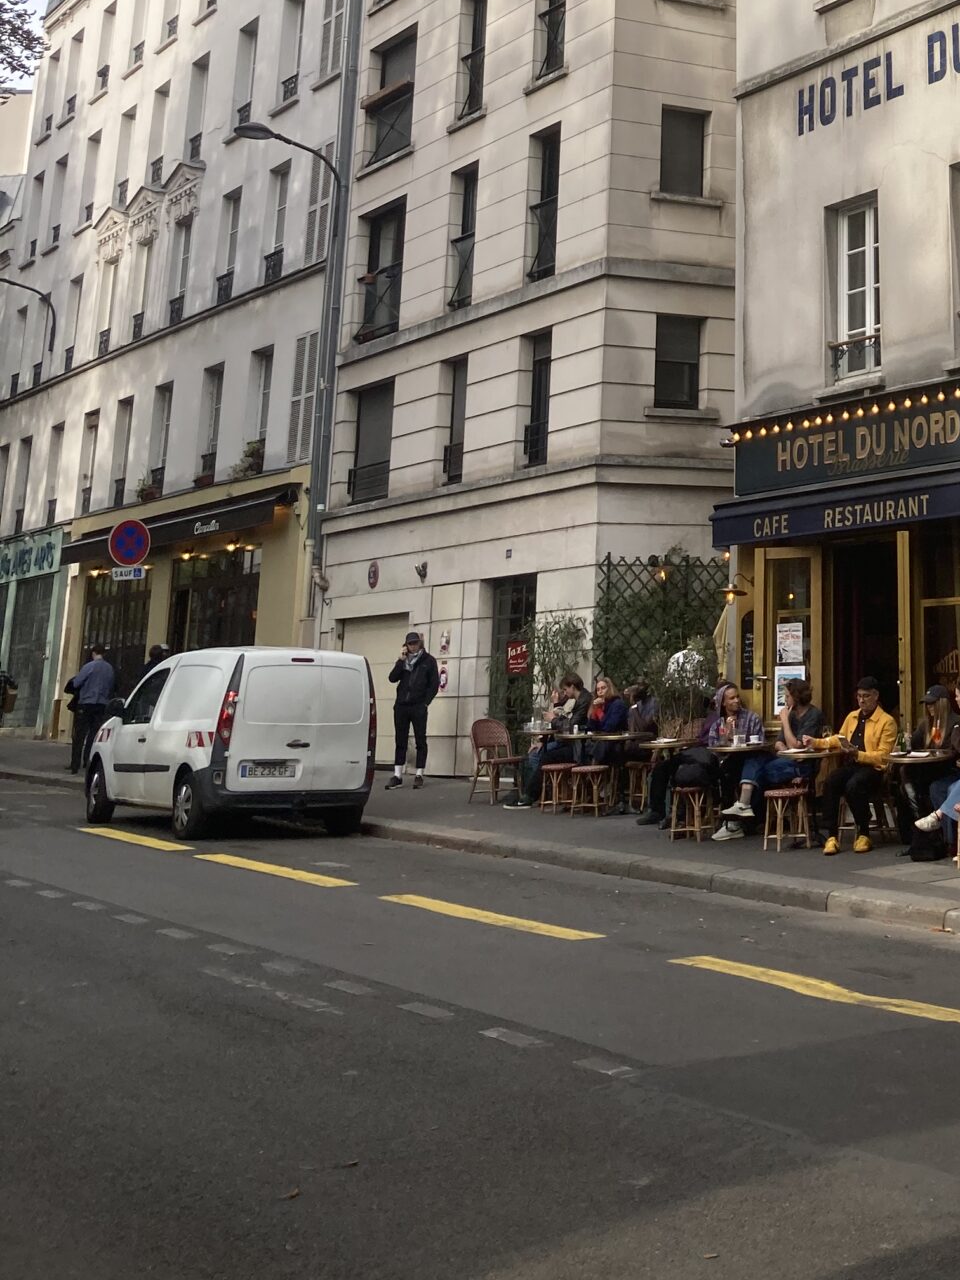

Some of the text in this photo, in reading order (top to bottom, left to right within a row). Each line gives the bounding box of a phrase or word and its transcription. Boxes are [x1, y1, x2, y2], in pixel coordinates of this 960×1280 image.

[798, 51, 904, 136] HOTEL
[777, 410, 960, 472] HOTEL DU NORD
[753, 494, 929, 538] CAFE RESTAURANT
[114, 569, 132, 578] SAUF
[508, 643, 527, 660] Jazz
[248, 766, 258, 776] BE
[260, 766, 276, 776] 232
